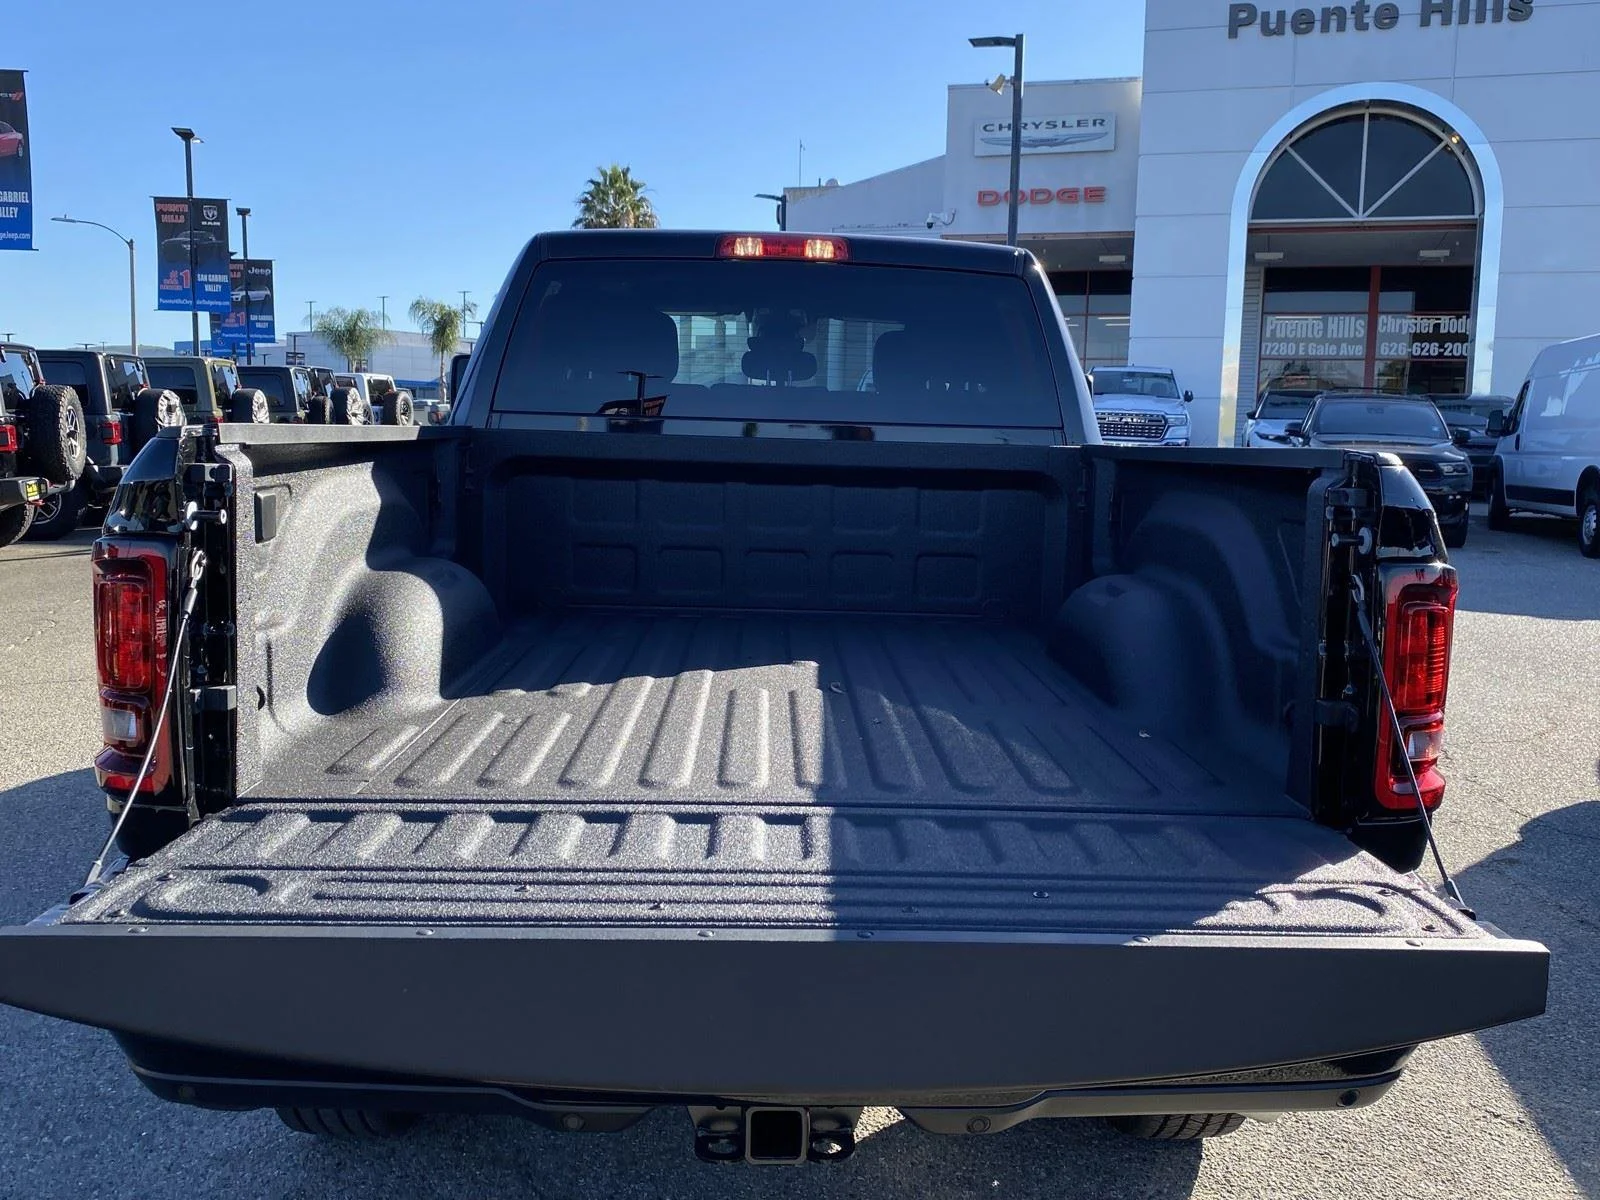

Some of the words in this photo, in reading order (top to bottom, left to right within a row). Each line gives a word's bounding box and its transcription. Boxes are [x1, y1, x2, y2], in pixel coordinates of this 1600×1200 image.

[1228, 2, 1400, 39] Puente
[1420, 0, 1534, 27] Hills
[982, 118, 1107, 132] CHRYSLER
[977, 186, 1107, 206] DODGE
[248, 266, 271, 277] Jeep
[204, 283, 222, 292] VALLEY
[1265, 316, 1324, 338] Puente
[1327, 315, 1365, 338] Hills
[1378, 314, 1436, 335] Chrysler
[1299, 343, 1305, 355] E
[1308, 342, 1337, 356] Gale
[1339, 342, 1363, 356] Ave
